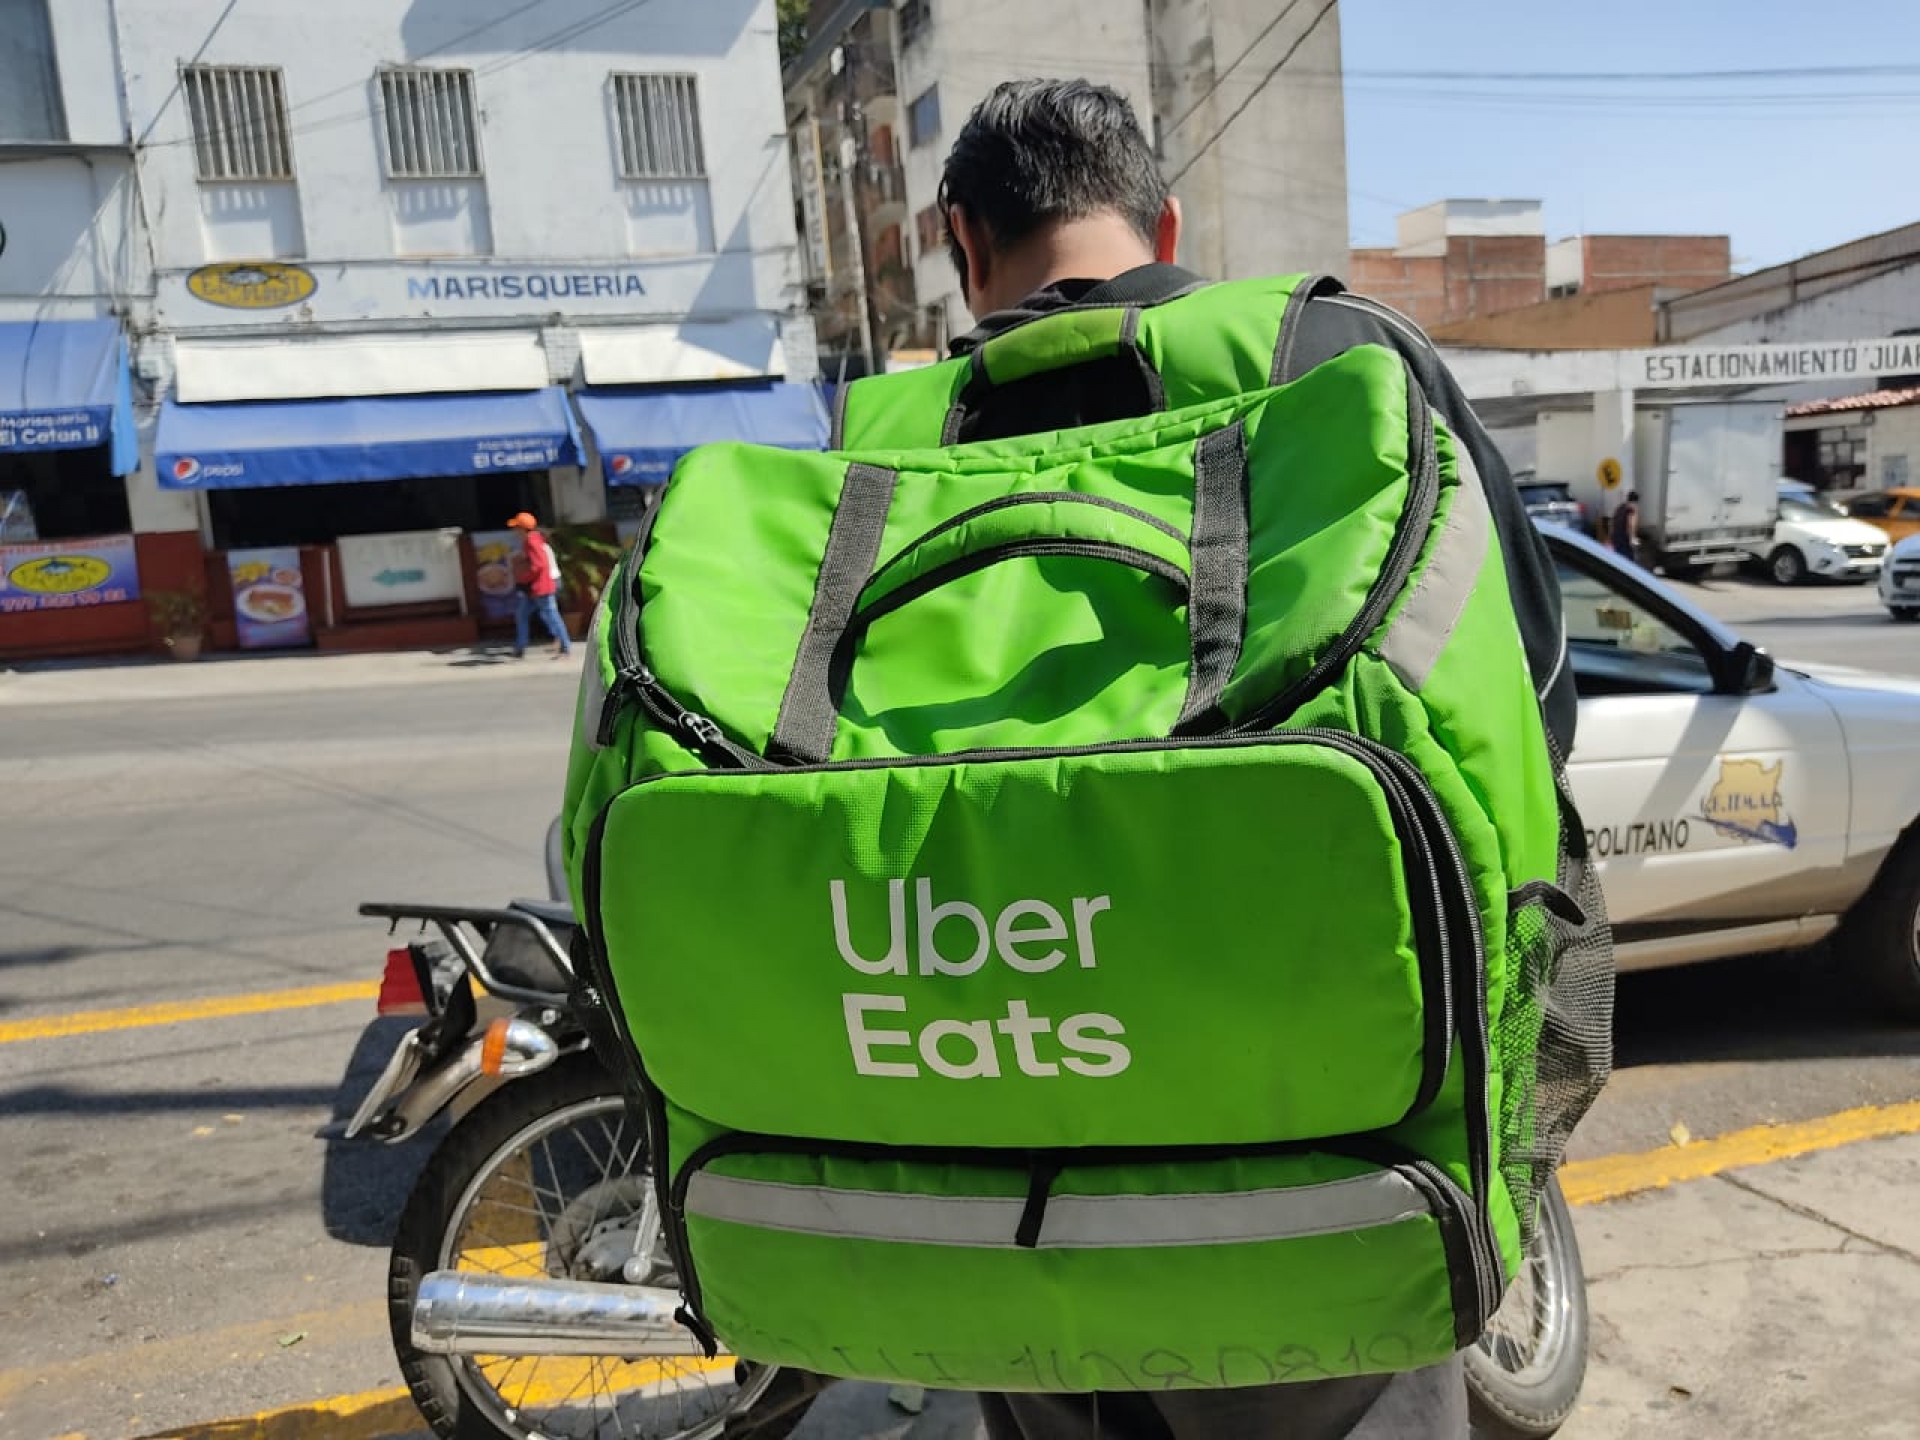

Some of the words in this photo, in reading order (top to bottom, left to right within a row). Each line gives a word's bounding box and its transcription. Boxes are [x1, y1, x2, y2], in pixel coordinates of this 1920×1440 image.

[407, 275, 646, 300] MARISQUERIA
[1646, 347, 1857, 381] ESTACIONAMIENTO
[829, 877, 1111, 976] Uber
[842, 993, 1132, 1079] Eats
